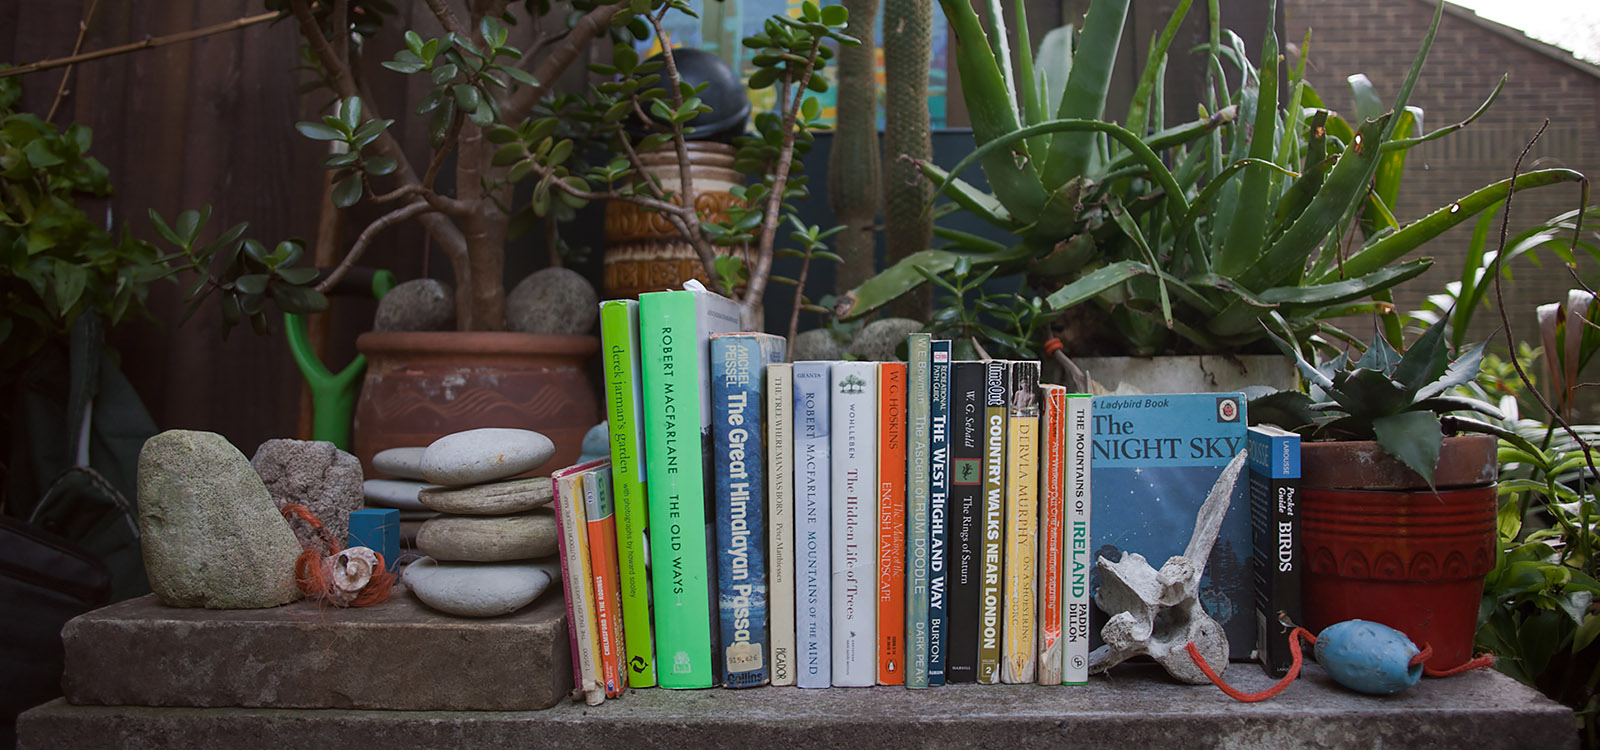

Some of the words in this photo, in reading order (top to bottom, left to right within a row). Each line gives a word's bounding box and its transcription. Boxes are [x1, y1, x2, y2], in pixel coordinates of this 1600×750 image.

[612, 345, 625, 378] derek
[662, 327, 674, 377] ROBERT
[725, 344, 737, 388] PEISSEL
[737, 344, 750, 388] MICHEL
[774, 377, 782, 396] THE
[940, 365, 948, 410] RECREATIONAL
[965, 390, 976, 401] W.
[612, 381, 627, 430] jarman's
[728, 391, 747, 426] The
[805, 392, 816, 438] ROBERT
[965, 404, 975, 415] G.
[1076, 408, 1085, 430] THE
[1092, 400, 1098, 408] A
[1100, 399, 1142, 410] Ladybird
[1144, 398, 1169, 408] Book
[664, 383, 678, 474] MACFARLANE
[888, 398, 899, 449] HOSKINS
[915, 415, 926, 437] The
[933, 415, 946, 443] THE
[964, 417, 975, 448] Sebald
[1092, 414, 1134, 435] The
[615, 433, 631, 474] garden
[728, 428, 749, 479] Great
[775, 452, 783, 471] MAN
[915, 441, 926, 483] Ascent
[988, 414, 1003, 485] COUNTRY
[1018, 424, 1030, 479] DERVLA
[1092, 438, 1182, 460] NIGHT
[1190, 436, 1241, 459] SKY
[846, 468, 858, 493] The
[932, 447, 946, 488] WEST
[1075, 432, 1085, 498] MOUNTAINS
[623, 483, 631, 497] with
[806, 444, 817, 524] MACFARLANE
[915, 487, 926, 499] of
[1278, 487, 1286, 513] Guide
[669, 494, 681, 518] THE
[881, 482, 892, 529] ENGLISH
[893, 503, 903, 517] The
[915, 502, 926, 533] RUM
[963, 495, 973, 514] The
[986, 488, 1001, 540] WALKS
[1018, 485, 1029, 547] MURPHY
[1075, 500, 1084, 516] OF
[1286, 486, 1295, 516] Pocket
[622, 498, 632, 539] photographs
[727, 482, 751, 581] Himalayan
[776, 523, 784, 540] Peter
[846, 496, 858, 540] Hidden
[931, 493, 946, 572] HIGHLAND
[960, 516, 972, 542] Rings
[567, 533, 576, 561] OUTDOOR
[626, 541, 633, 549] by
[670, 524, 682, 551] OLD
[891, 521, 903, 555] Making
[961, 543, 972, 554] of
[1278, 521, 1293, 572] BIRDS
[628, 550, 636, 575] howard
[776, 541, 784, 583] Matthiessen
[808, 531, 817, 604] MOUNTAINS
[846, 544, 858, 568] Life
[880, 535, 892, 602] LANDSCAPE
[891, 556, 903, 566] of
[914, 538, 926, 594] DOODLE
[961, 554, 972, 584] Saturn
[985, 543, 999, 585] NEAR
[1023, 556, 1030, 570] ON
[1072, 520, 1086, 598] IRELAND
[596, 576, 604, 600] RODINGS
[629, 576, 637, 598] sooley
[672, 556, 684, 594] WAYS
[846, 570, 858, 583] of
[893, 567, 903, 579] the
[846, 584, 858, 620] Trees
[931, 576, 945, 609] WAY
[577, 605, 586, 628] ENGLISH
[809, 607, 817, 618] OF
[984, 587, 998, 649] LONDON
[1022, 582, 1030, 642] SHOESTRING
[1069, 603, 1077, 643] DILLON
[1078, 603, 1087, 639] PADDY
[600, 619, 610, 656] CHELMSFORD
[809, 622, 817, 638] THE
[916, 622, 925, 651] DARK
[931, 618, 941, 663] BURTON
[776, 647, 787, 680] PICADOR
[808, 641, 818, 675] MIND
[916, 654, 925, 683] PEAK
[986, 666, 992, 674] 2
[728, 672, 763, 685] Collins
